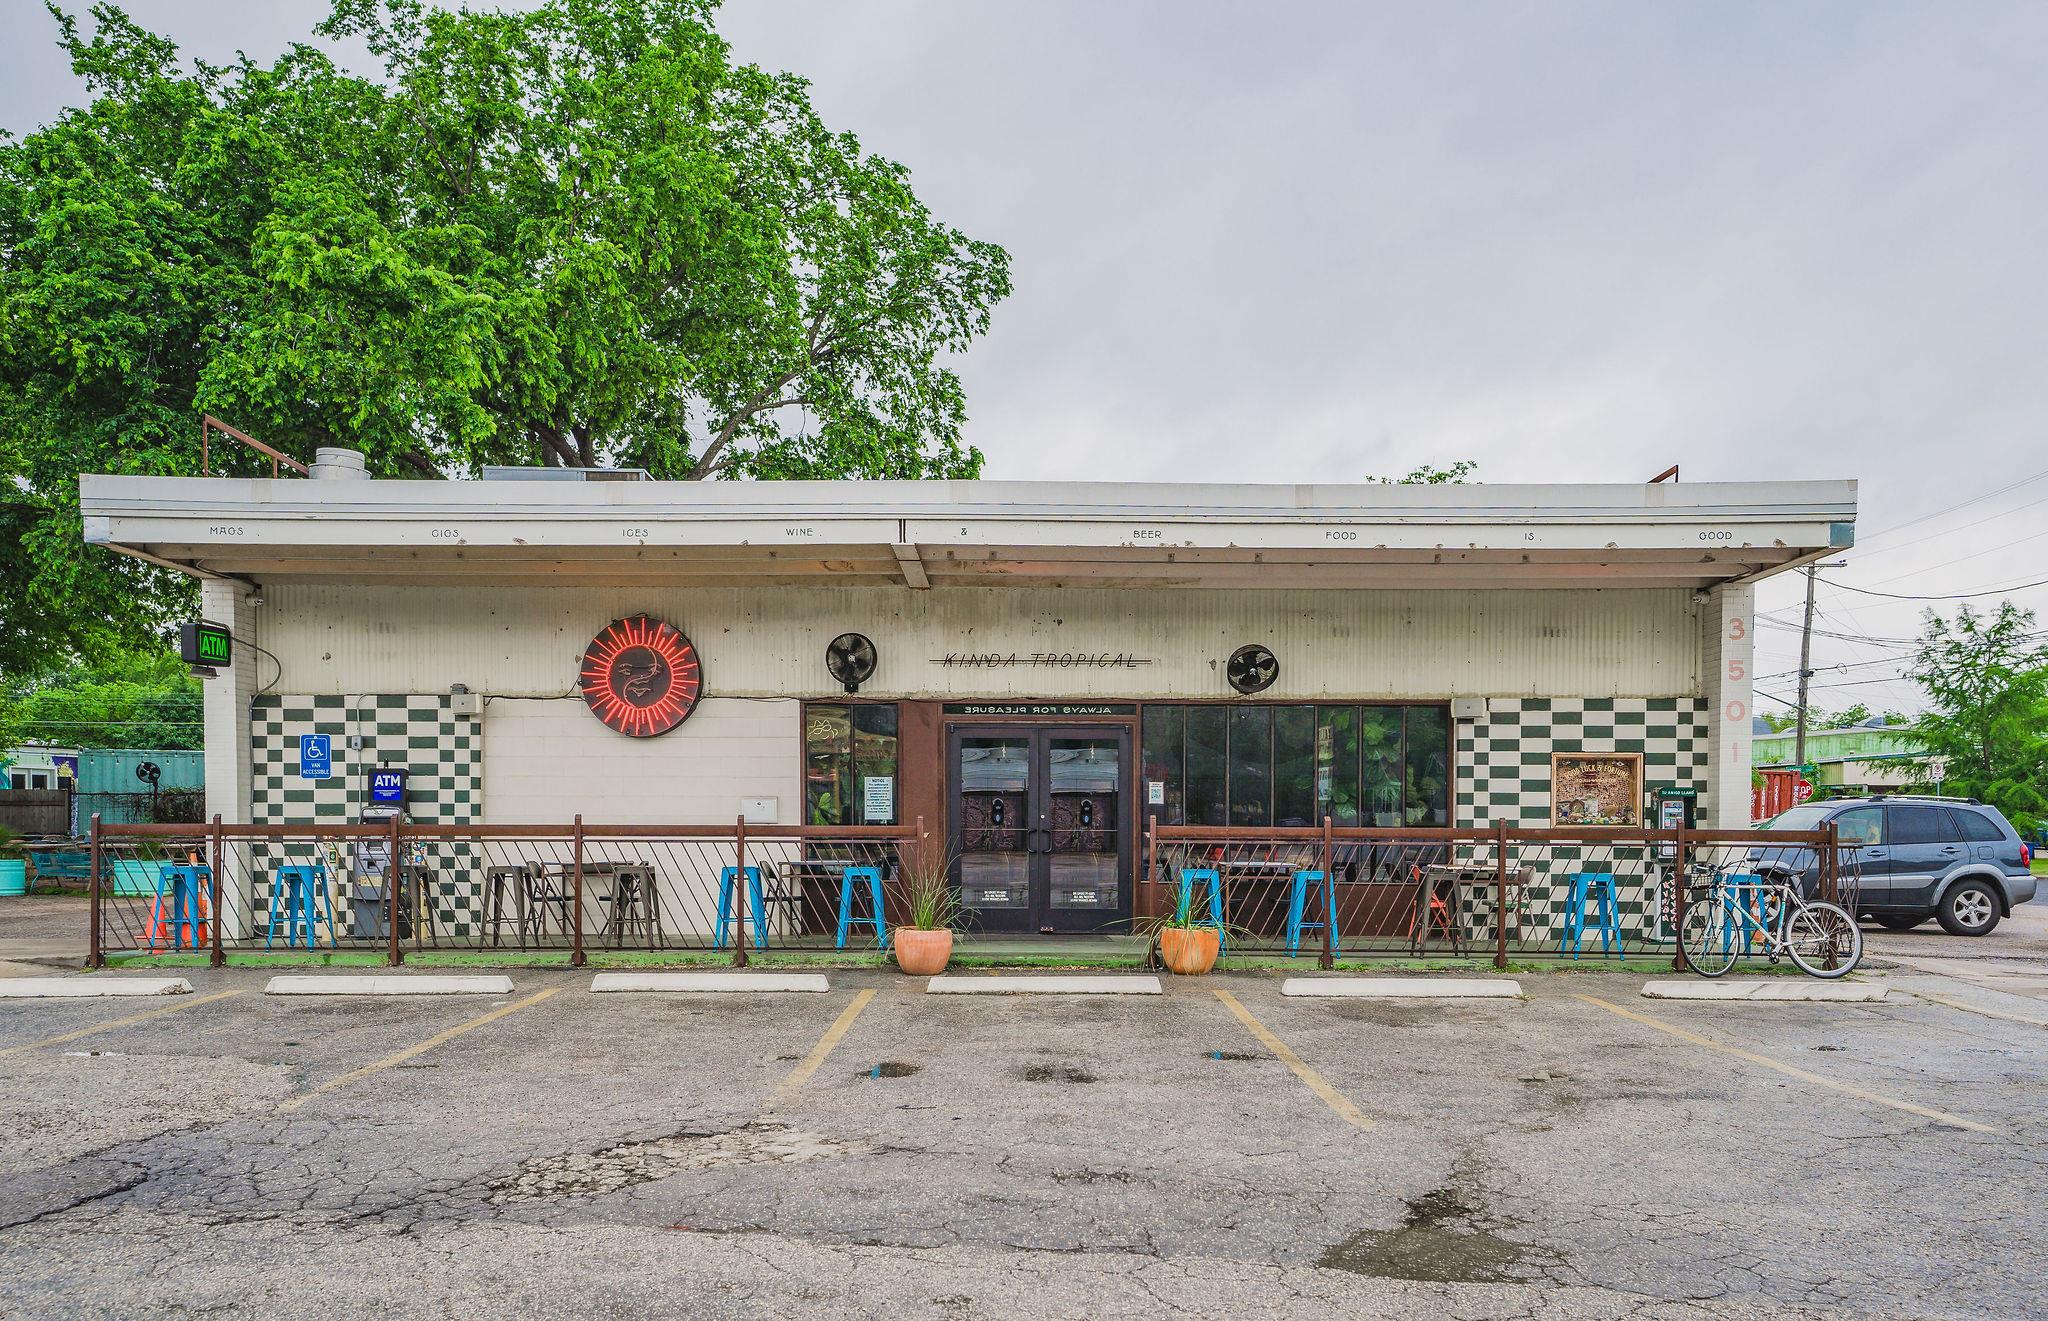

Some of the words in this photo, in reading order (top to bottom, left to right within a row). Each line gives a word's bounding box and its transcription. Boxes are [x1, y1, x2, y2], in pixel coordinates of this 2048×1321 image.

[785, 527, 813, 537] WINE
[960, 527, 968, 536] &
[1133, 530, 1162, 539] BEER
[1325, 531, 1357, 540] FOOD
[1524, 532, 1535, 541] IS
[1699, 531, 1733, 541] GOOD
[201, 635, 227, 657] ATM
[943, 653, 1016, 668] KINDA
[1030, 653, 1137, 668] TROPICAL
[374, 775, 401, 786] ATM
